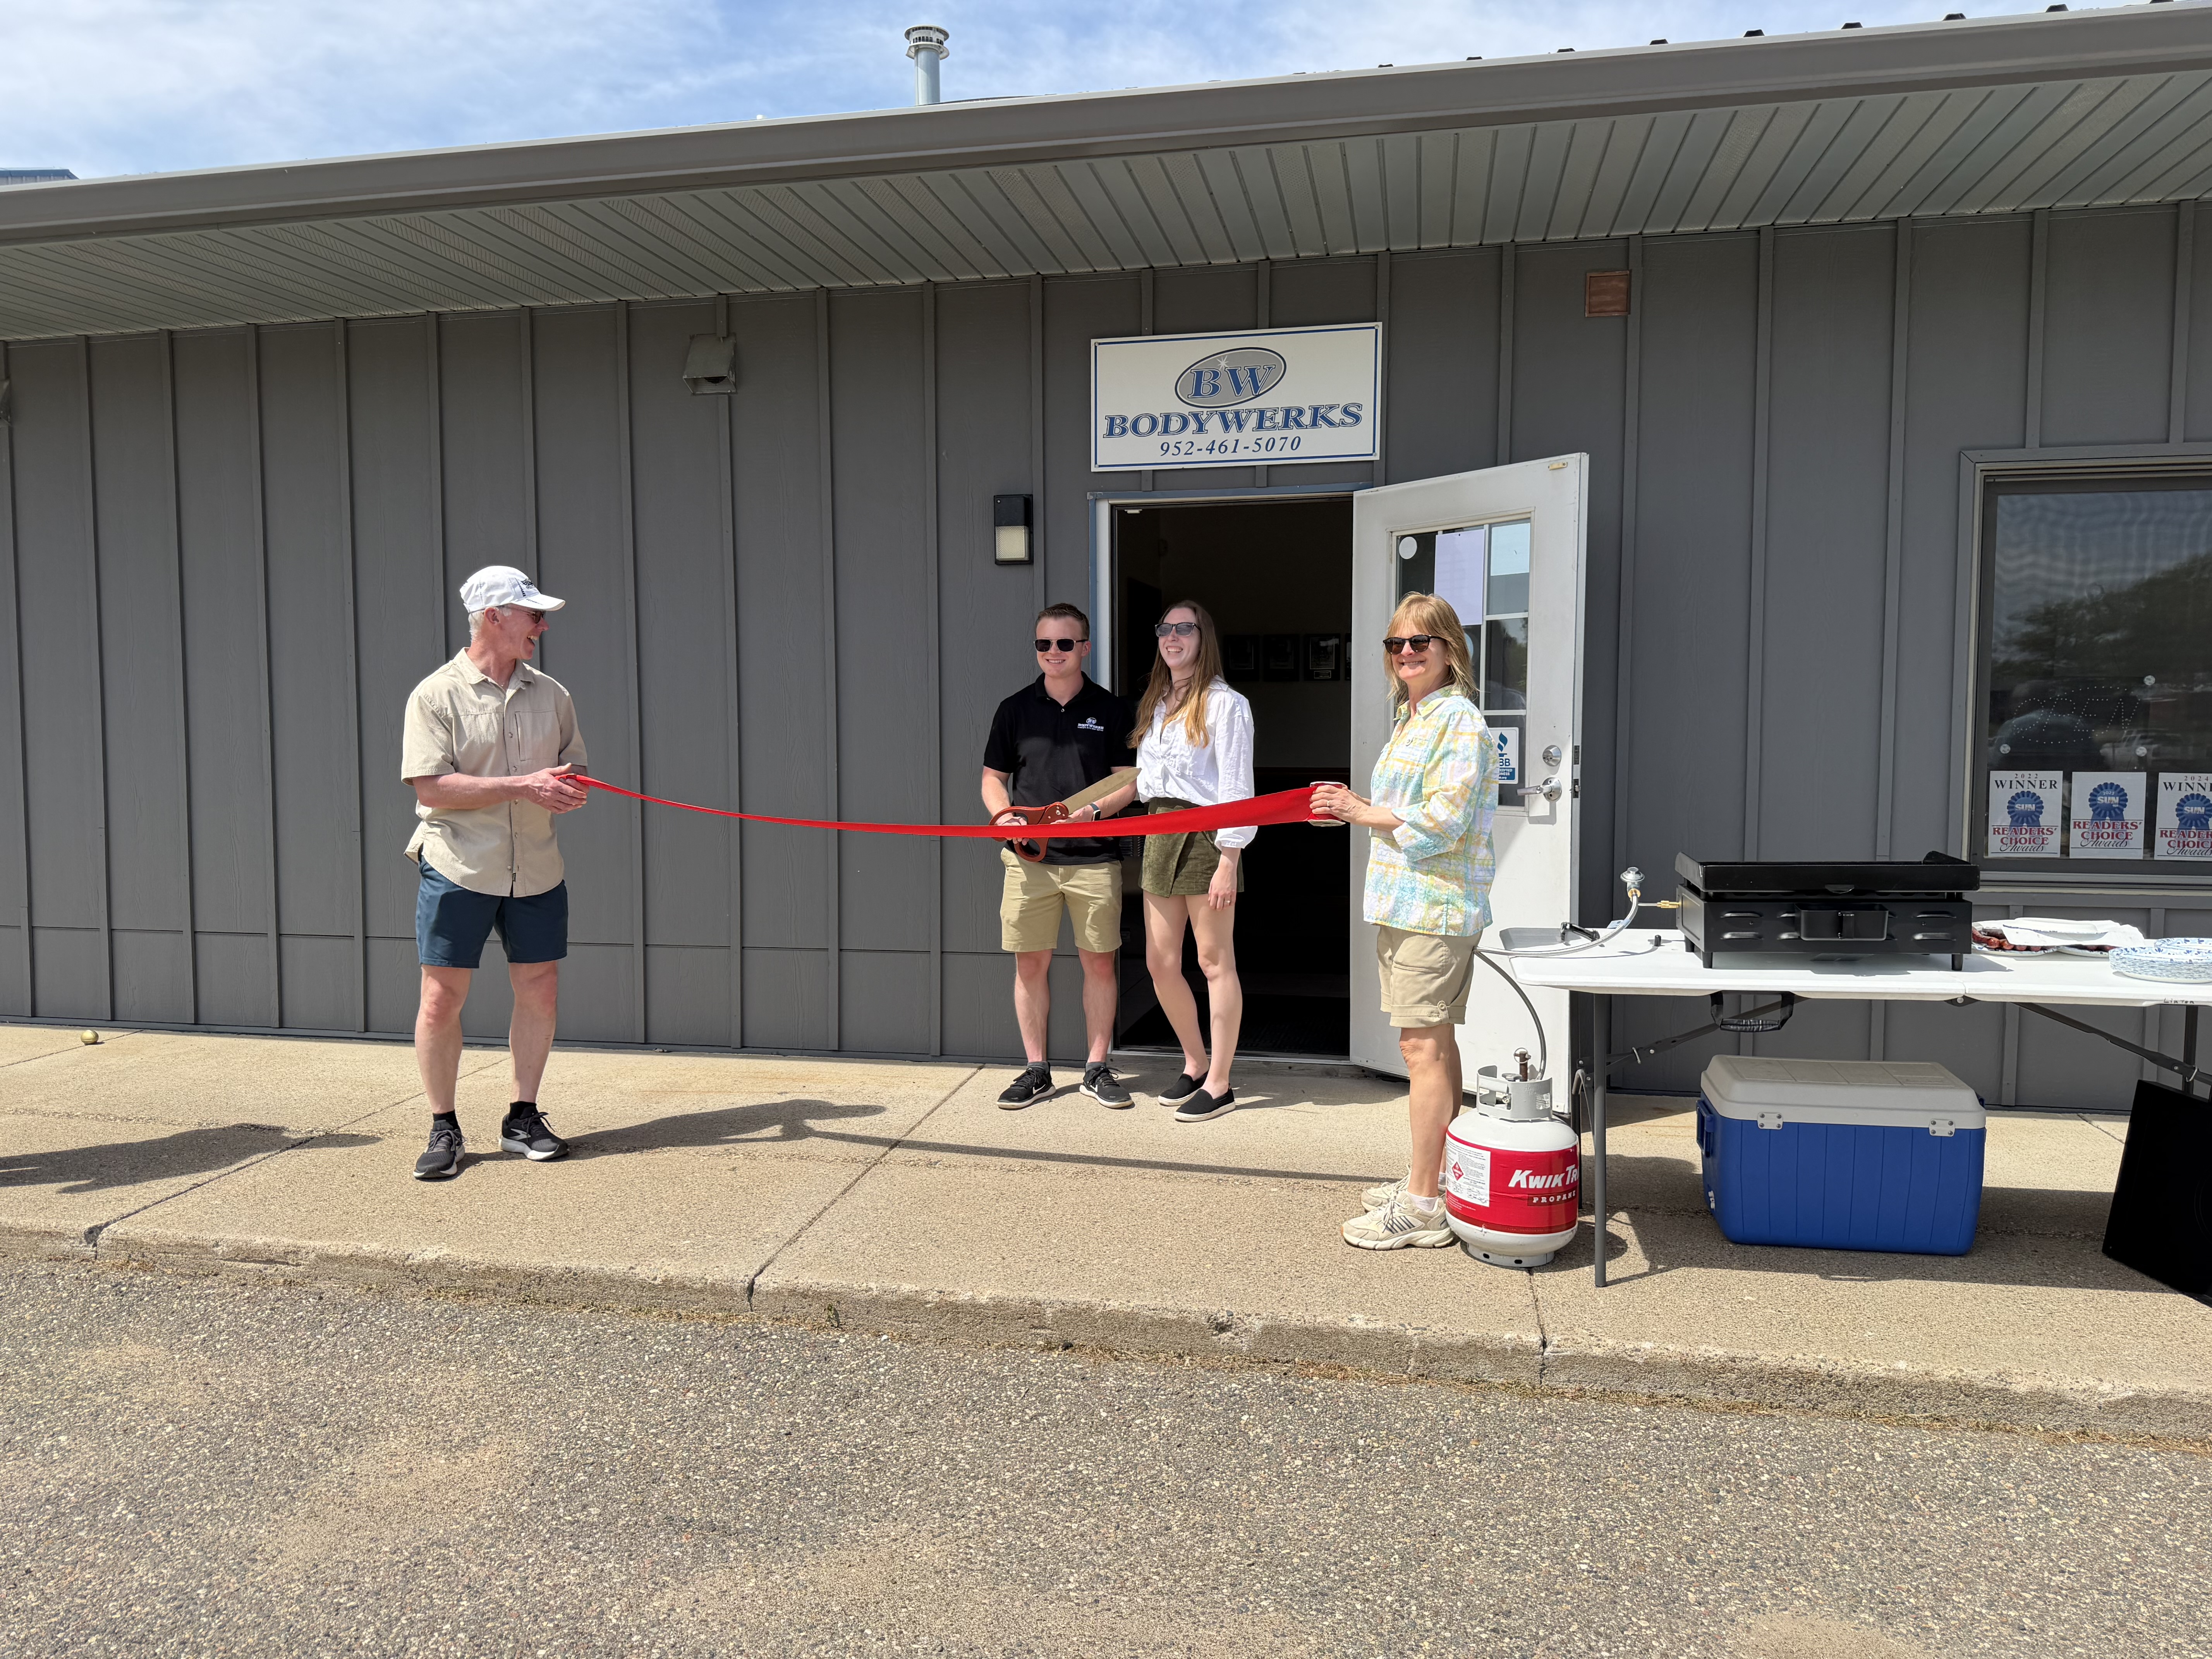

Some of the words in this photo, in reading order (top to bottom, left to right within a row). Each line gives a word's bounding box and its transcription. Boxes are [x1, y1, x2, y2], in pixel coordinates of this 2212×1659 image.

[1187, 364, 1276, 399] BW
[1103, 402, 1363, 438] BODYWERKS
[1160, 436, 1302, 457] 952-461-5070
[1499, 758, 1510, 766] BB
[1994, 780, 2057, 789] WINNER
[2097, 796, 2119, 804] SUN
[2073, 821, 2142, 830] READERS'
[1993, 827, 2057, 835] READERS'
[2081, 831, 2133, 840] CHOICE
[2160, 830, 2212, 839] READER
[2000, 837, 2049, 845] CHOICE
[2080, 836, 2128, 847] Awards
[2167, 840, 2212, 849] CHOIC
[1999, 842, 2044, 852] Awards
[1508, 1170, 1565, 1189] KWIK
[1532, 1190, 1576, 1203] PROPANE
